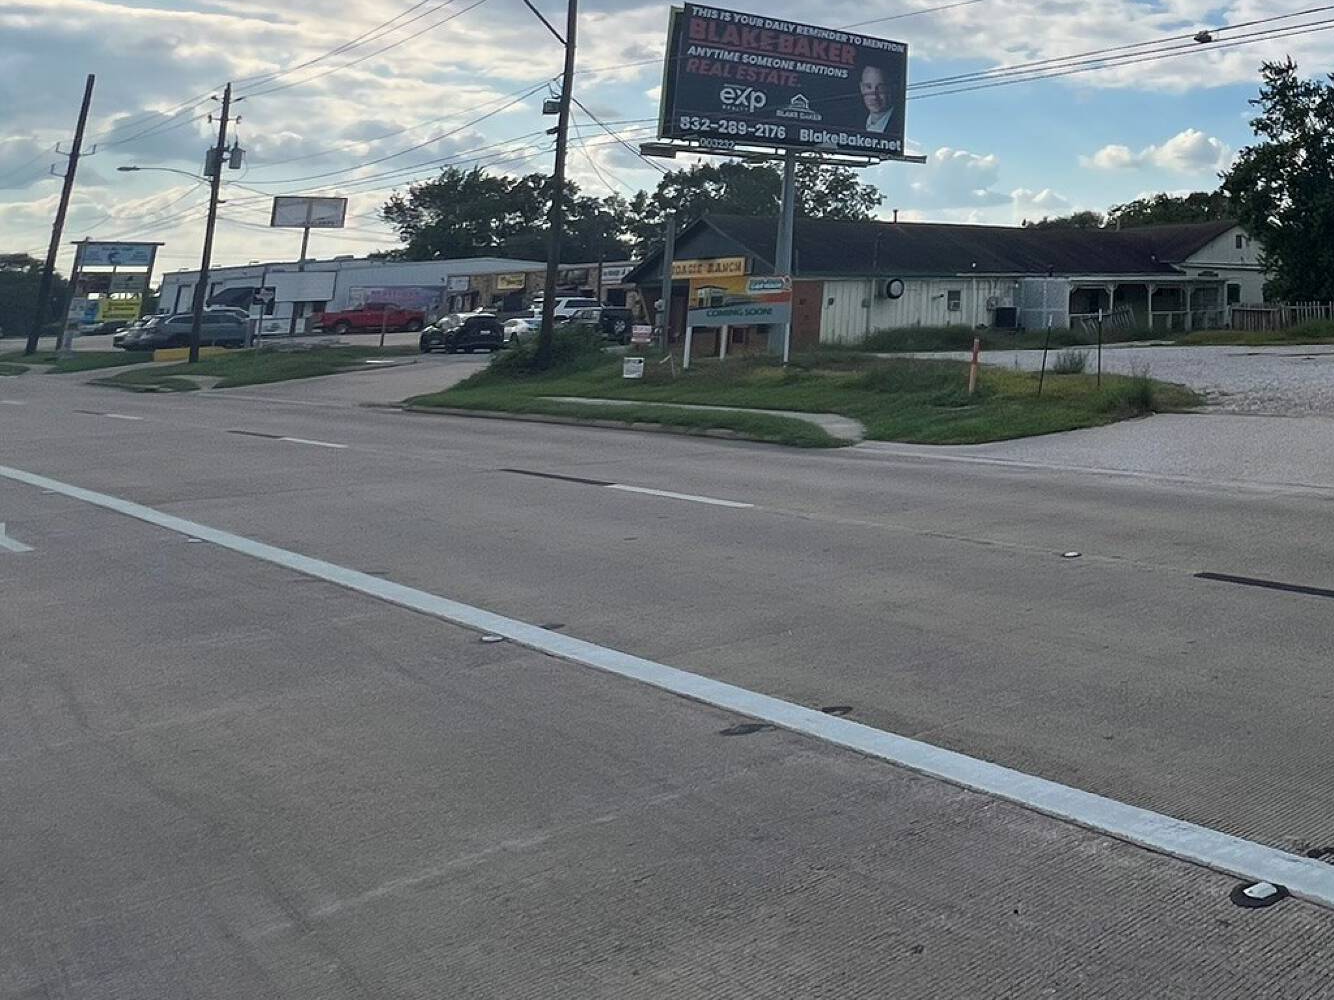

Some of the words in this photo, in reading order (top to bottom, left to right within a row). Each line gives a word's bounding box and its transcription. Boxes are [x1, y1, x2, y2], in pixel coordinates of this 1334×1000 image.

[688, 17, 776, 51] BLAKE
[776, 33, 858, 65] BAKER
[691, 6, 719, 20] THIS
[719, 11, 732, 22] IS
[733, 13, 764, 28] YOUR
[765, 19, 796, 34] DAILY
[796, 25, 849, 43] REMINDER
[849, 34, 862, 46] TO
[862, 37, 905, 54] MENTION
[686, 59, 738, 78] REAL
[738, 67, 802, 88] ESTATE.
[687, 46, 742, 63] ANYTIME
[742, 53, 796, 71] SOMEONE
[796, 62, 850, 79] MENTIONS
[775, 109, 799, 119] BLAKE
[799, 128, 902, 152] BlakeBaker.net
[706, 308, 743, 318] COMING
